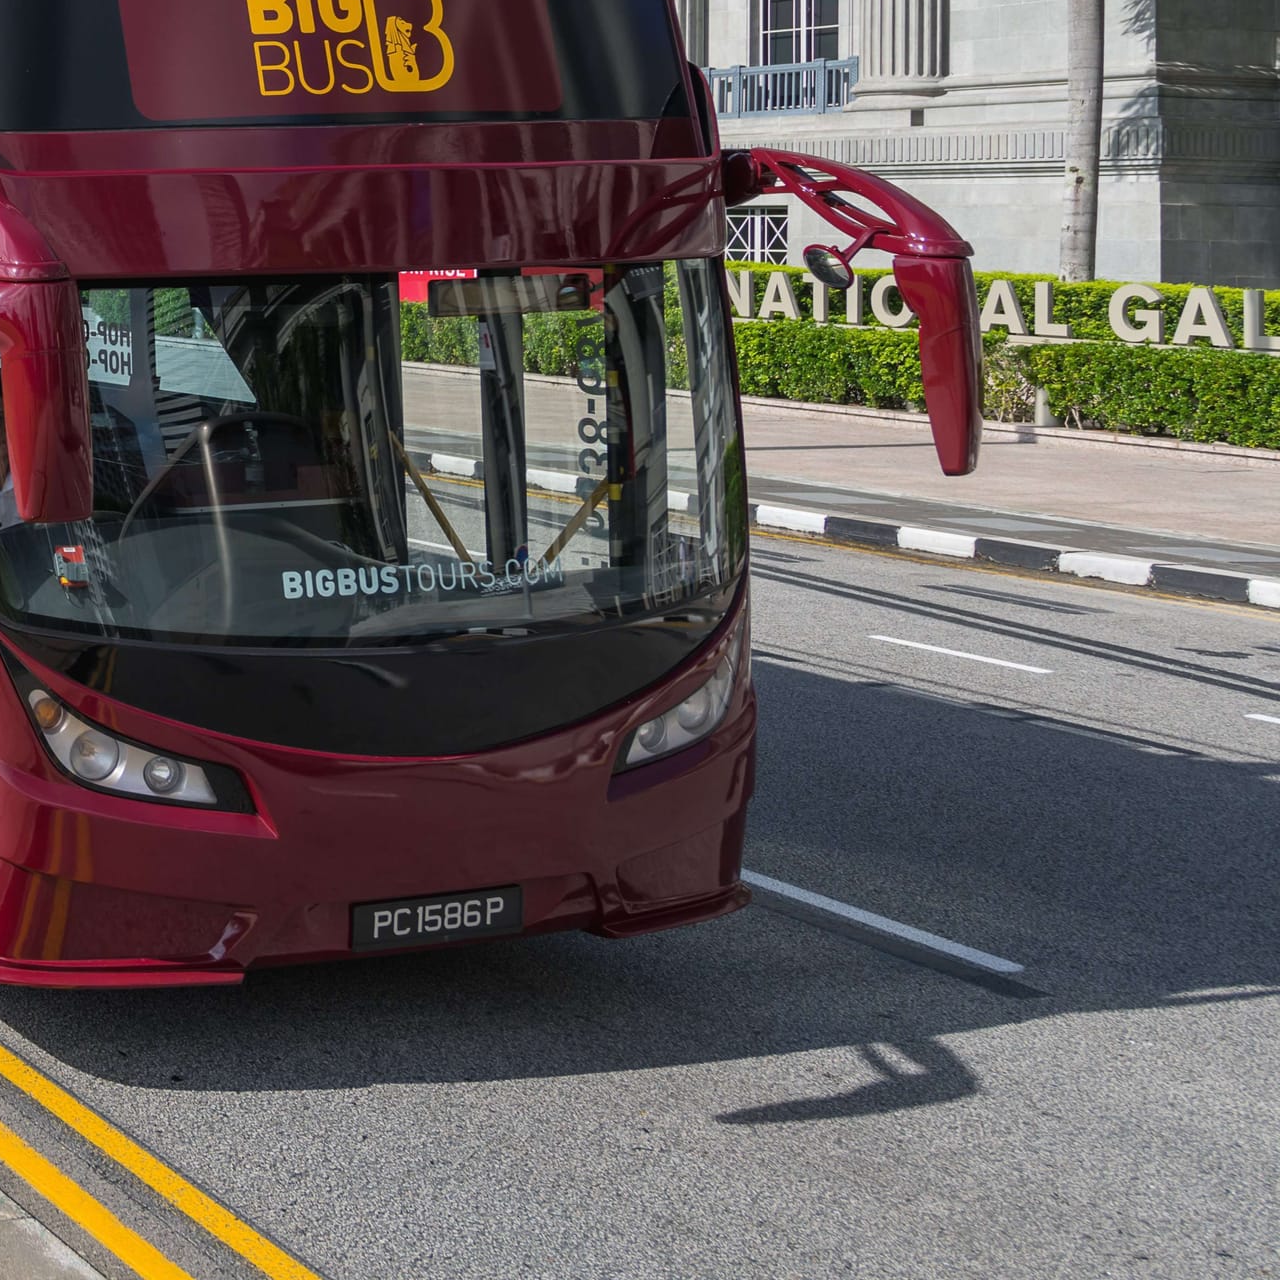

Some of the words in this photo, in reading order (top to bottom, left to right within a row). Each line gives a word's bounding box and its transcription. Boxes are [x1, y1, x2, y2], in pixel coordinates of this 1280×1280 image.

[253, 39, 374, 97] BUS
[726, 270, 1072, 339] NATIOAL
[282, 556, 564, 600] BIGBUSTOURS.COM
